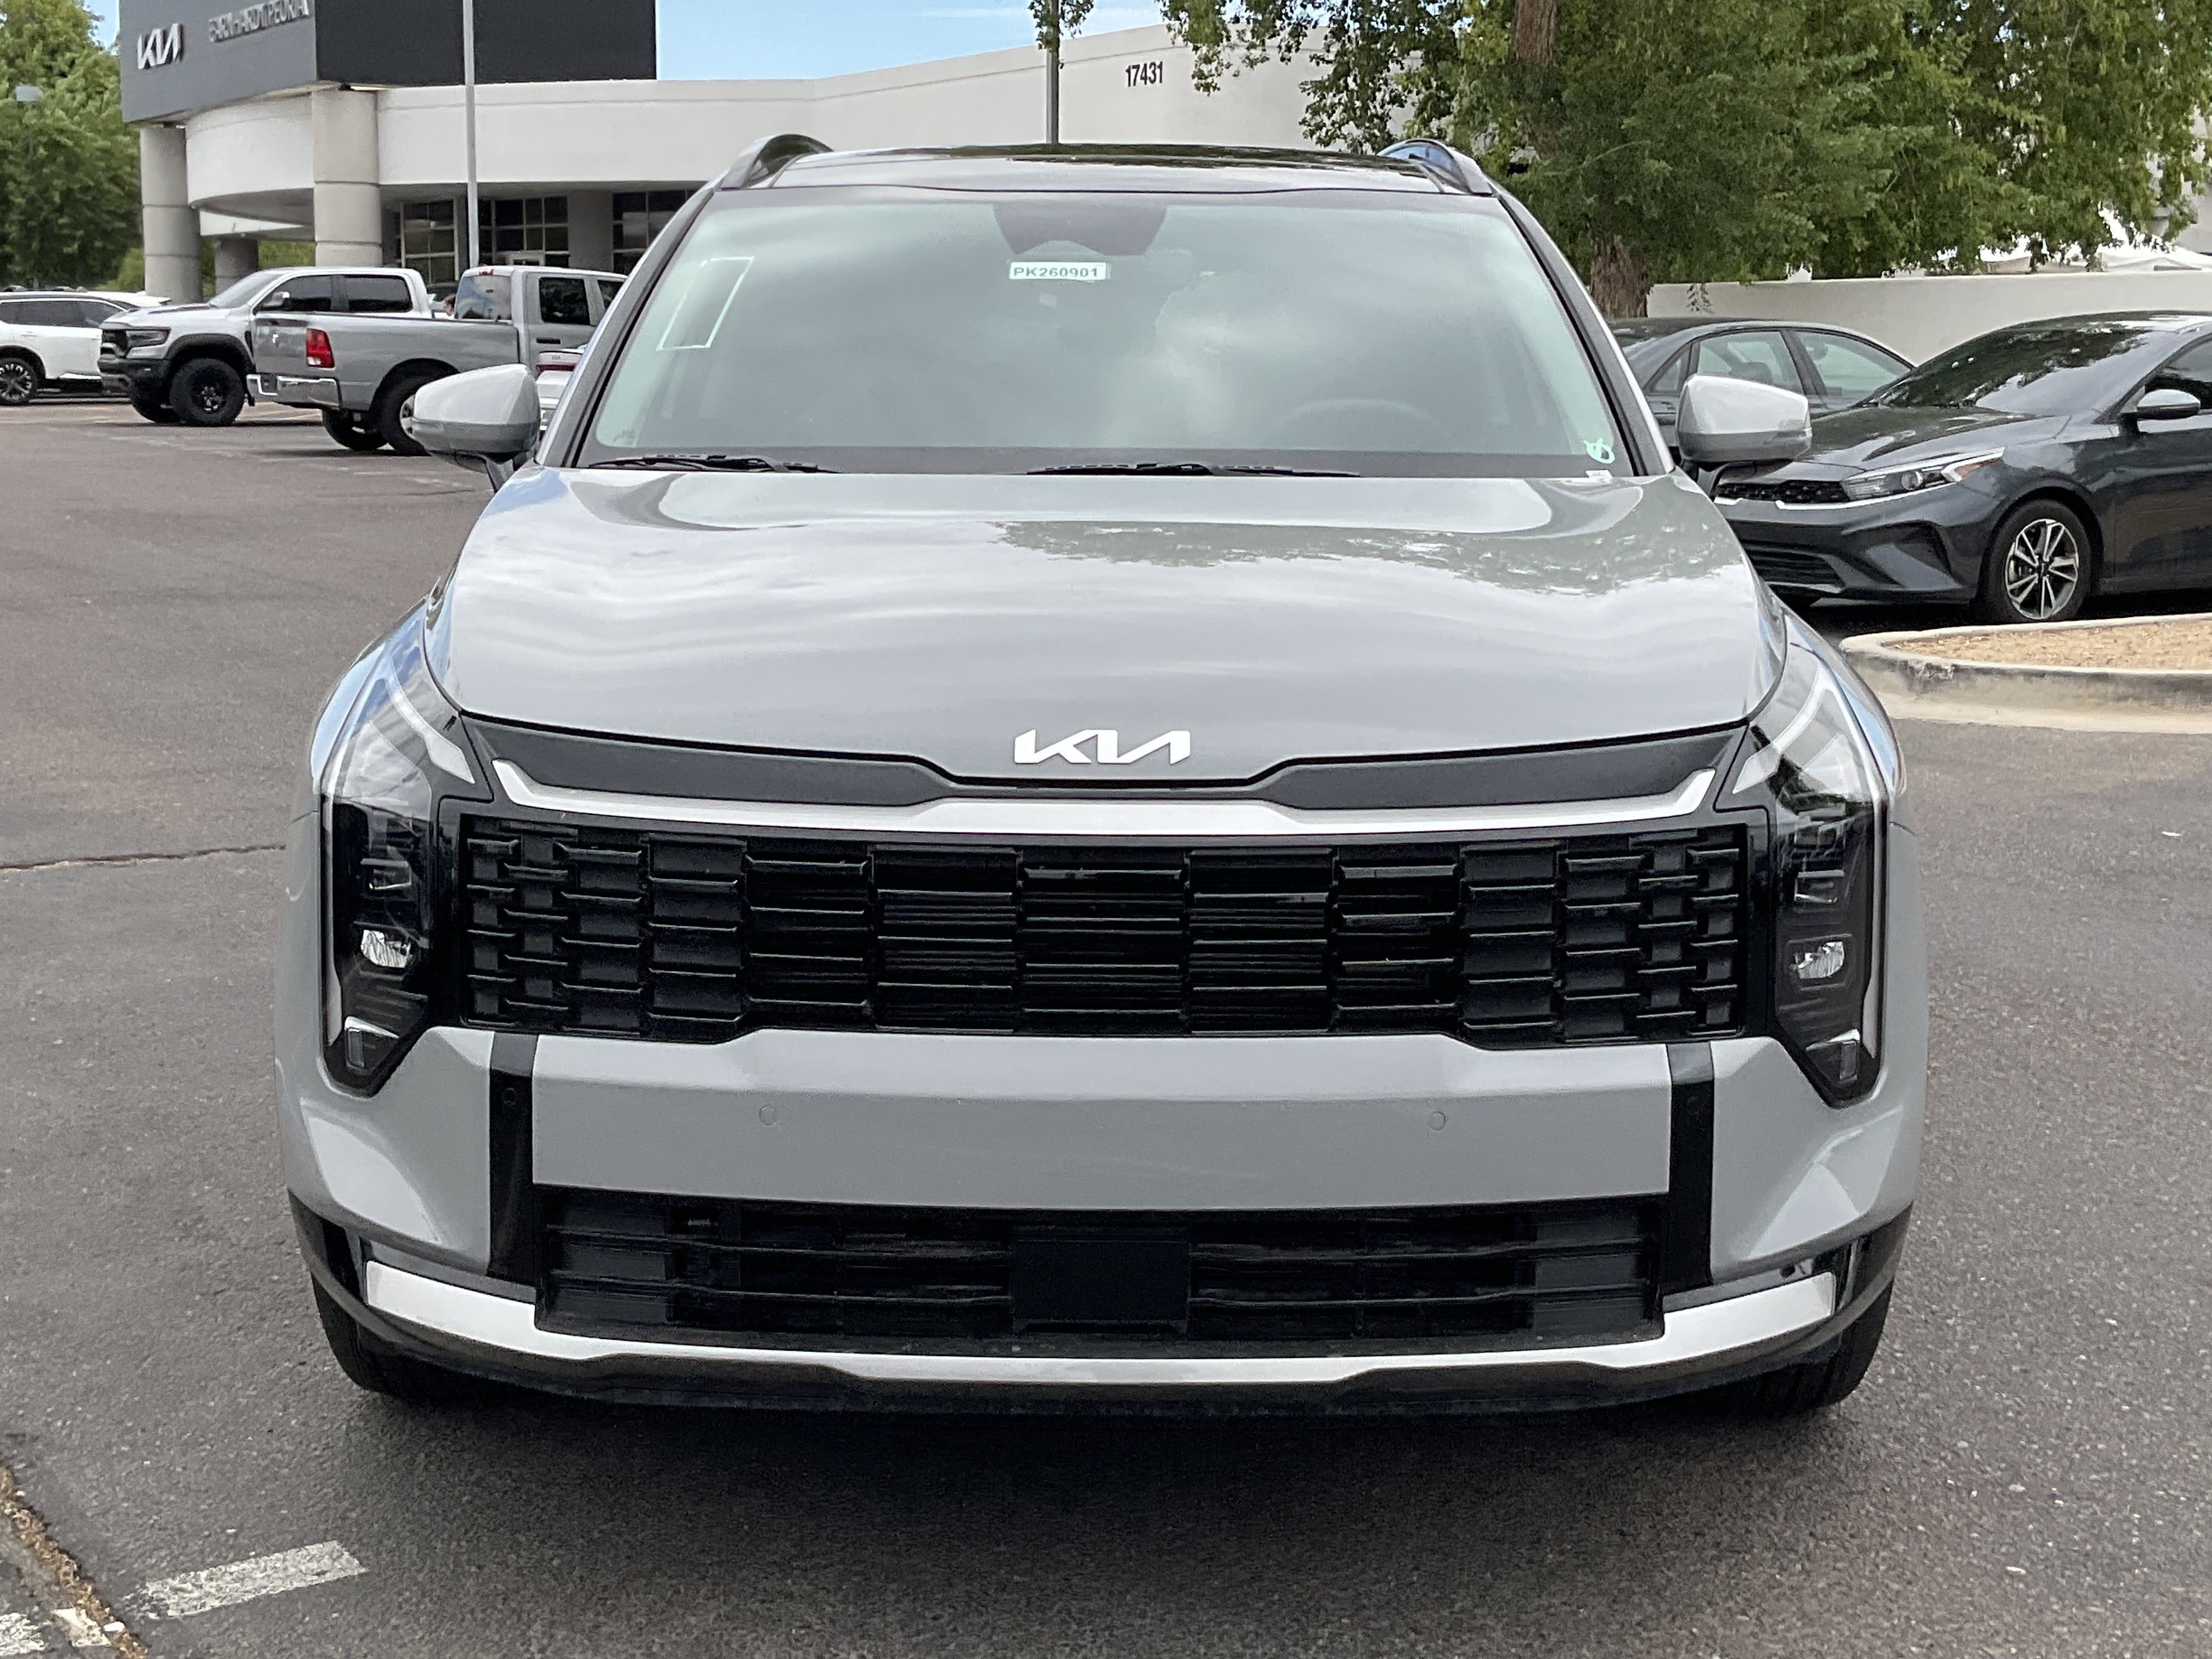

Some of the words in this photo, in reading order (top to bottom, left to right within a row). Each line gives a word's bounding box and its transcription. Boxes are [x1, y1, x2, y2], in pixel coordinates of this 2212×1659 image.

[137, 23, 180, 69] KIA
[1125, 61, 1163, 87] 17431
[1013, 267, 1098, 278] PK260901
[1014, 729, 1191, 765] KIA
